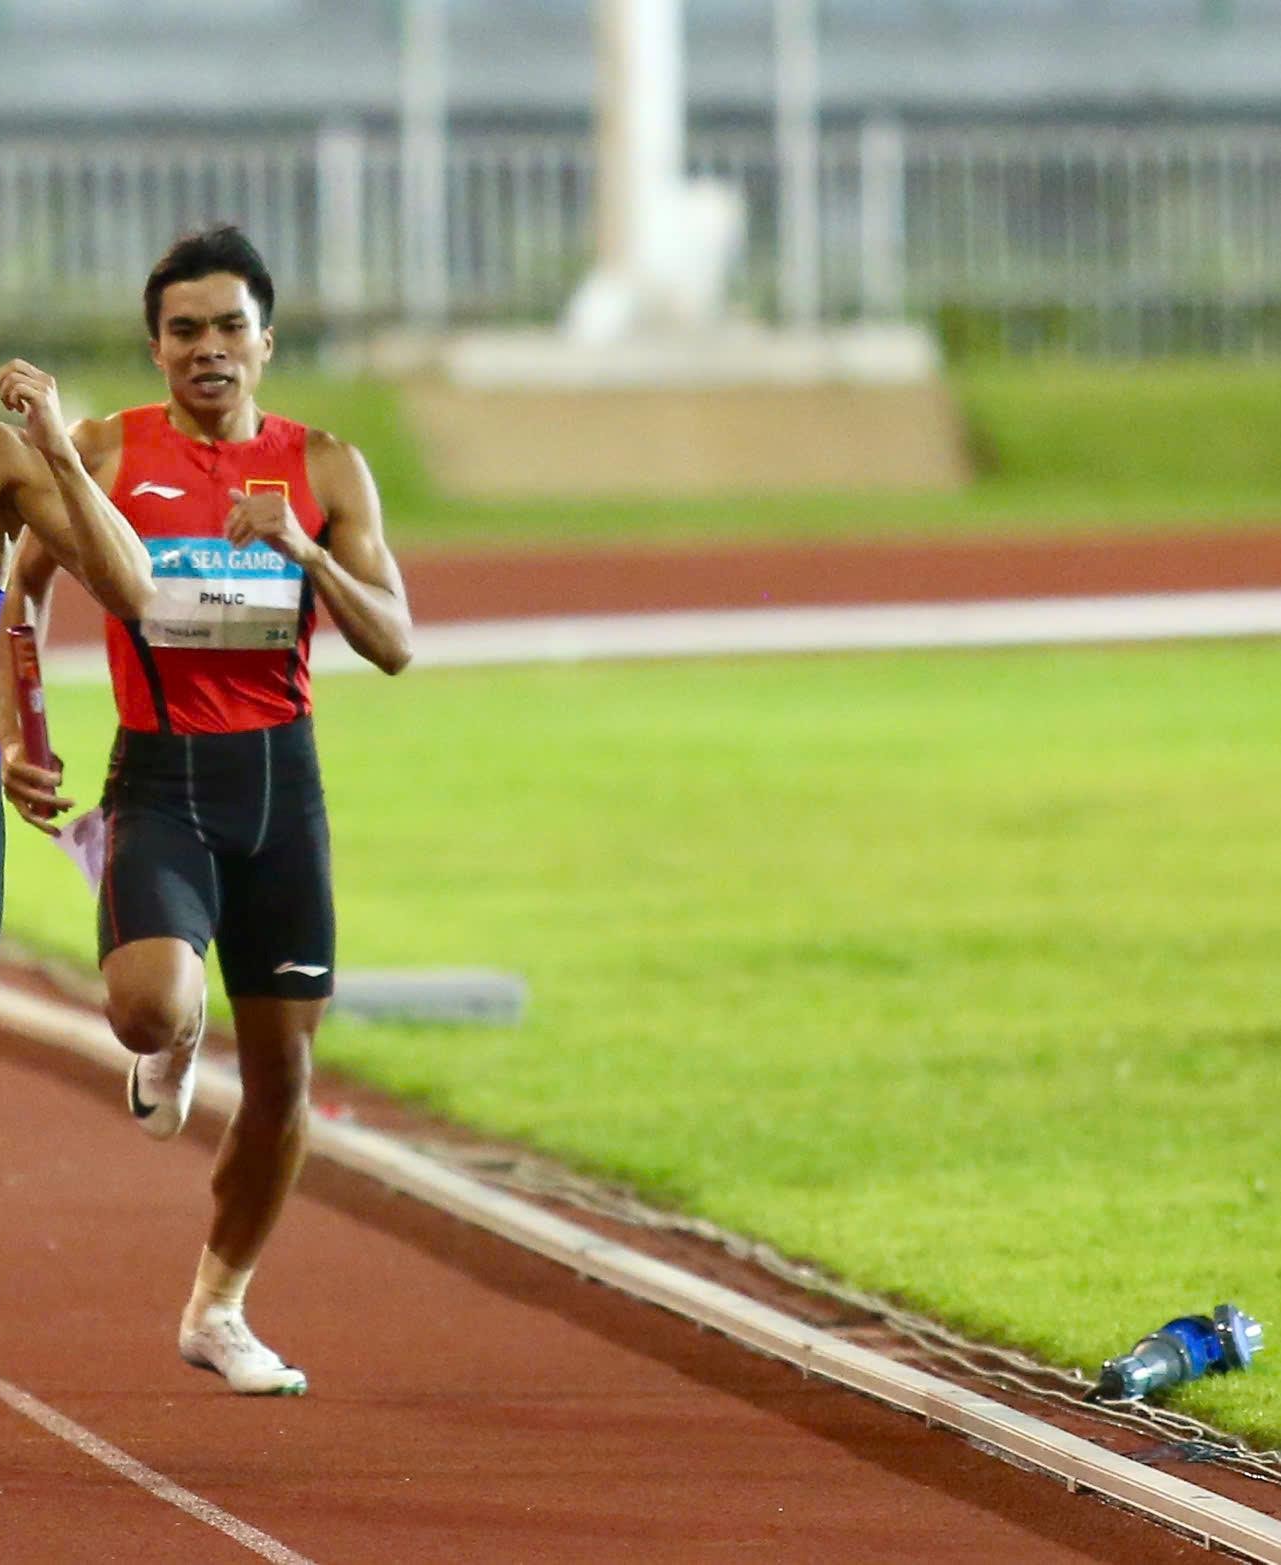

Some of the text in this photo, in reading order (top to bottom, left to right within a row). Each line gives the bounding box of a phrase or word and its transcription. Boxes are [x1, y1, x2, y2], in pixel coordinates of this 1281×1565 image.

[191, 551, 224, 569] SEA
[228, 551, 286, 570] GAMES
[200, 592, 245, 605] PHUC
